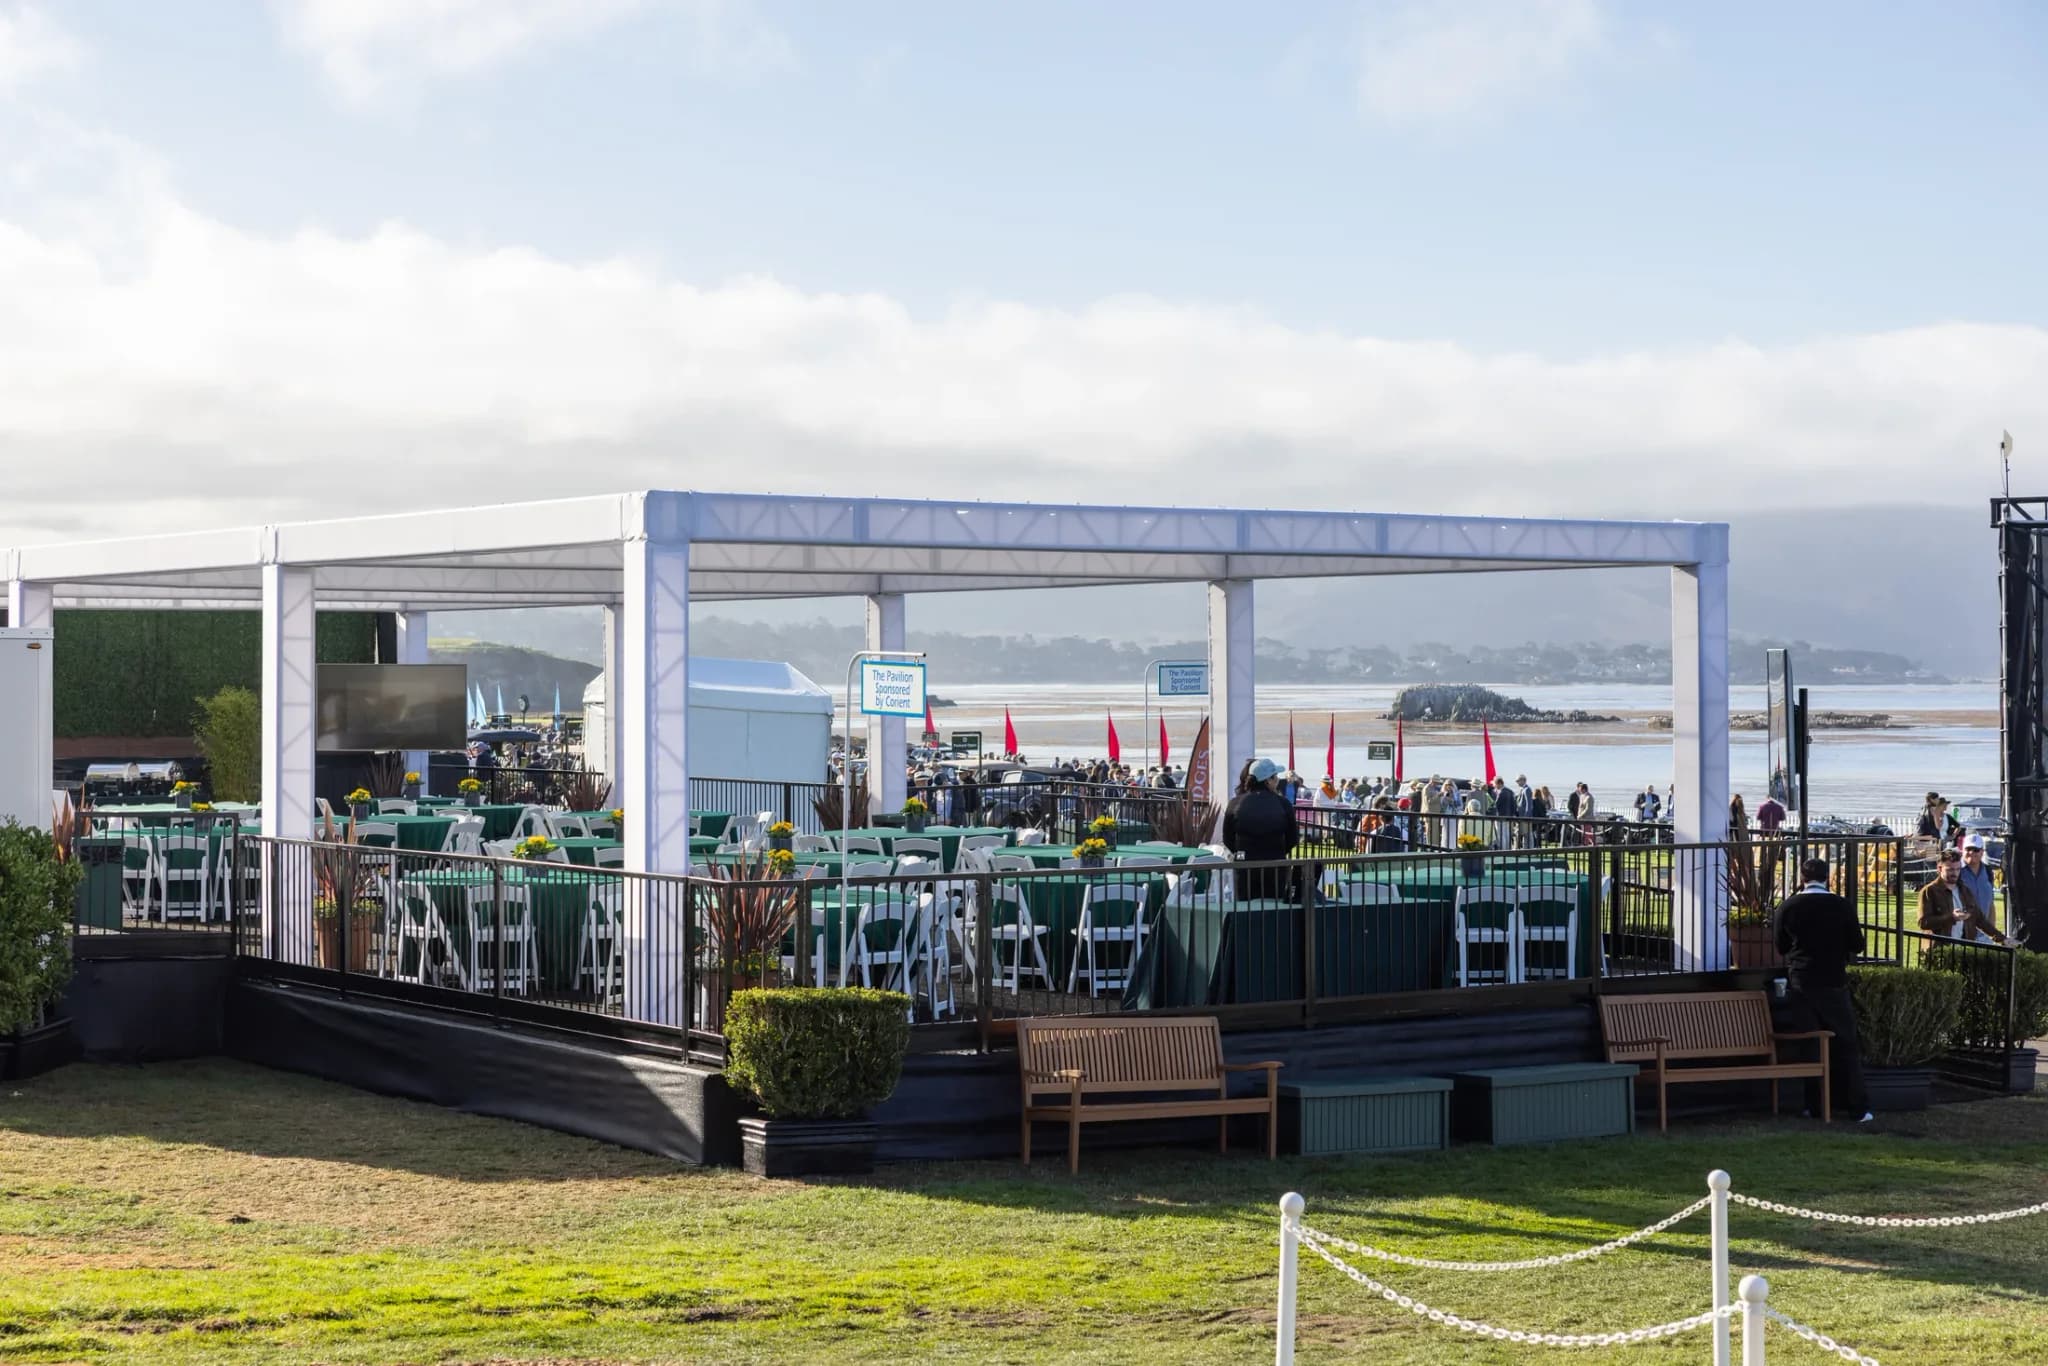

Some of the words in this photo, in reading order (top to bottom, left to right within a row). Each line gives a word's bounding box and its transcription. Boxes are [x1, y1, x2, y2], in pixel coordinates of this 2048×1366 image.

[872, 669, 885, 681] The
[886, 670, 914, 682] Pavilion
[875, 683, 911, 696] Sponsored
[875, 696, 884, 709] by
[885, 696, 911, 708] Corient
